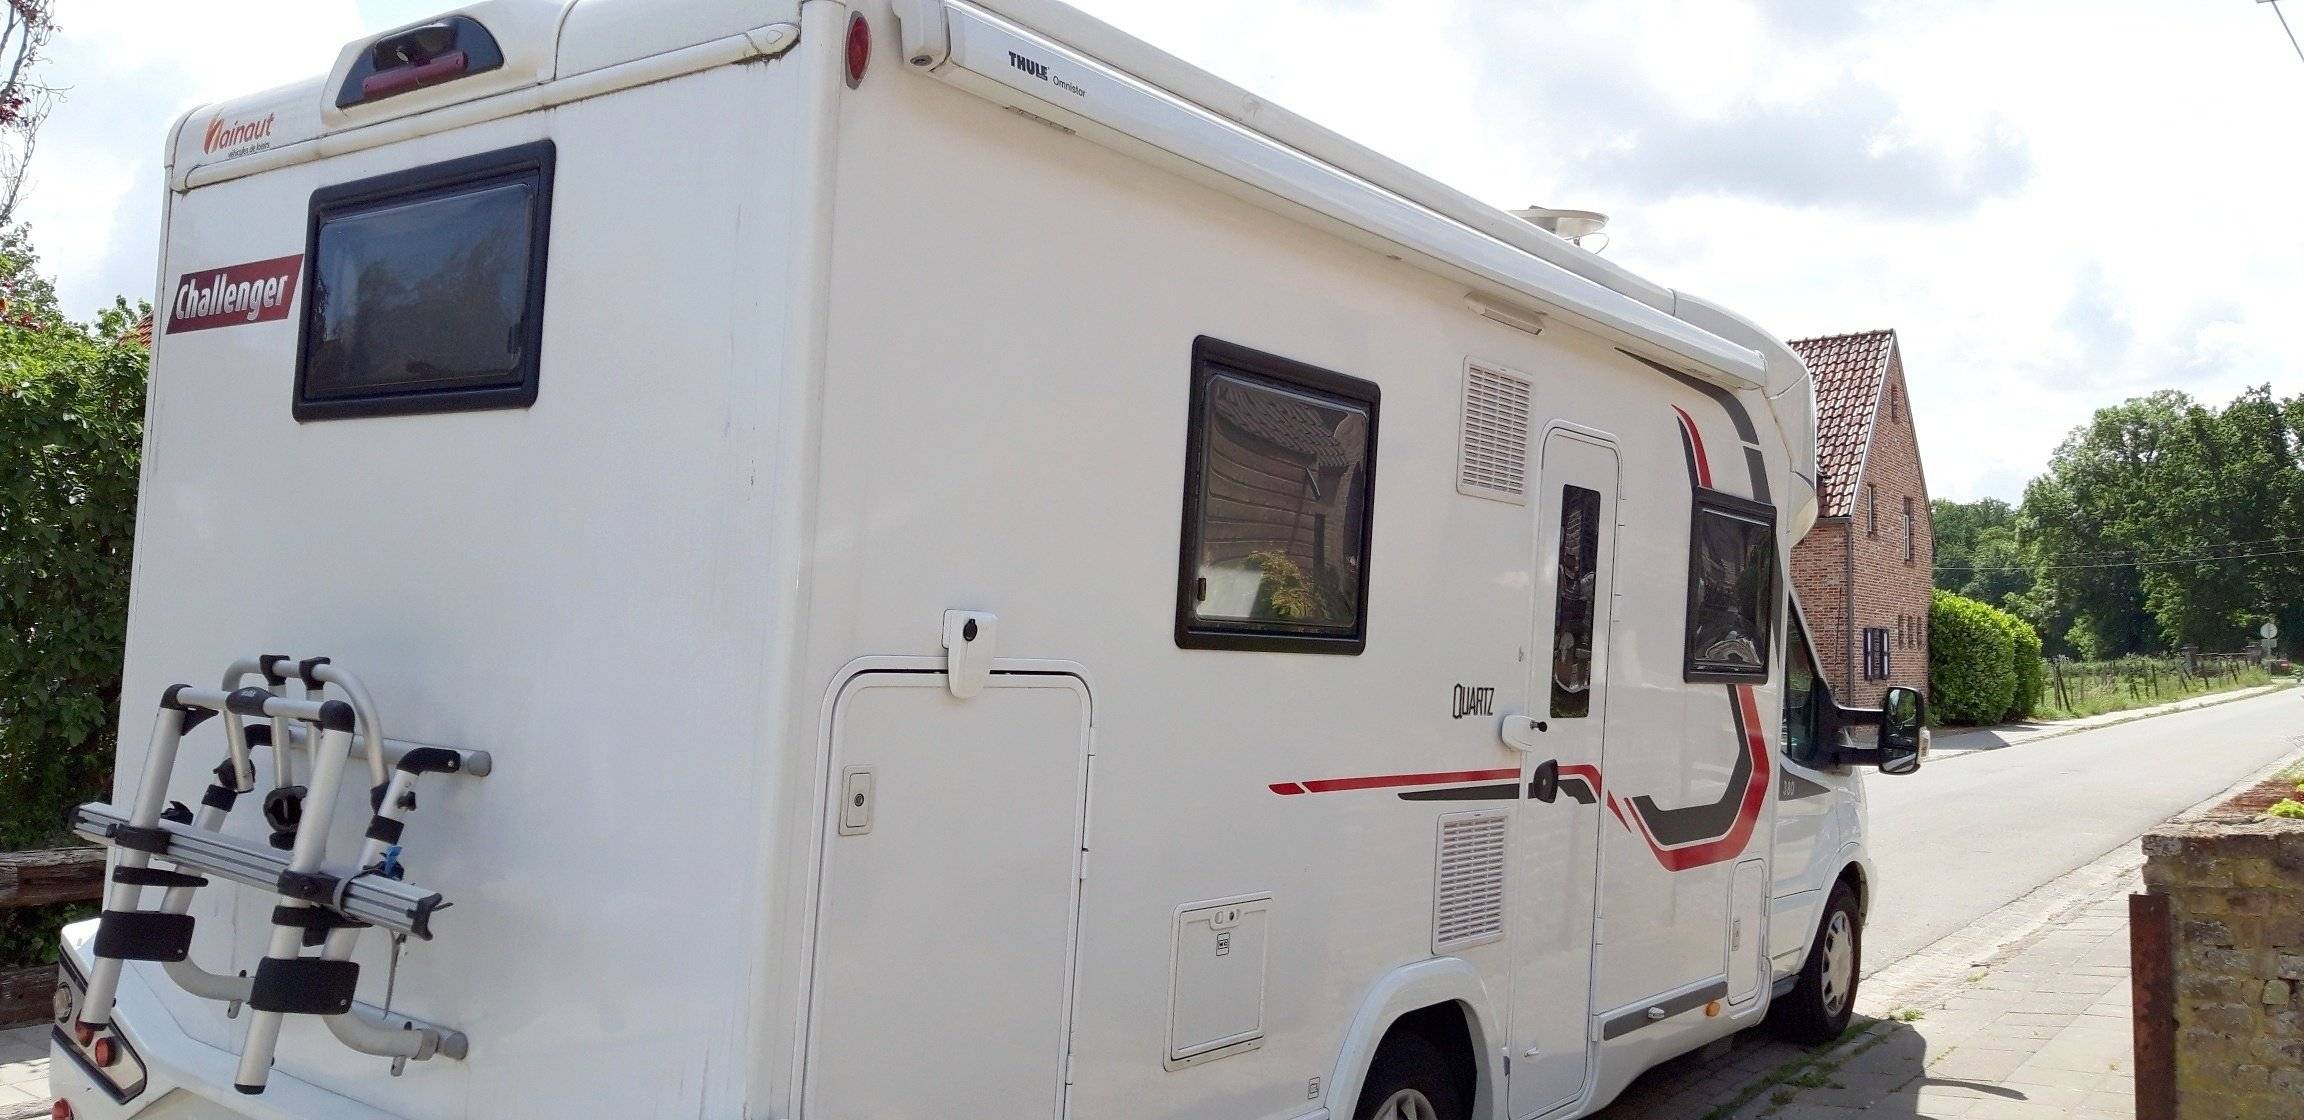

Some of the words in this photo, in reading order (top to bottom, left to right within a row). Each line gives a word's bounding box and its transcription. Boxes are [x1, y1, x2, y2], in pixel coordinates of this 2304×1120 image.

[1008, 51, 1048, 81] THULE
[1052, 75, 1087, 97] Omnistor
[176, 273, 288, 321] Challenger
[1453, 683, 1494, 719] QUARTZ
